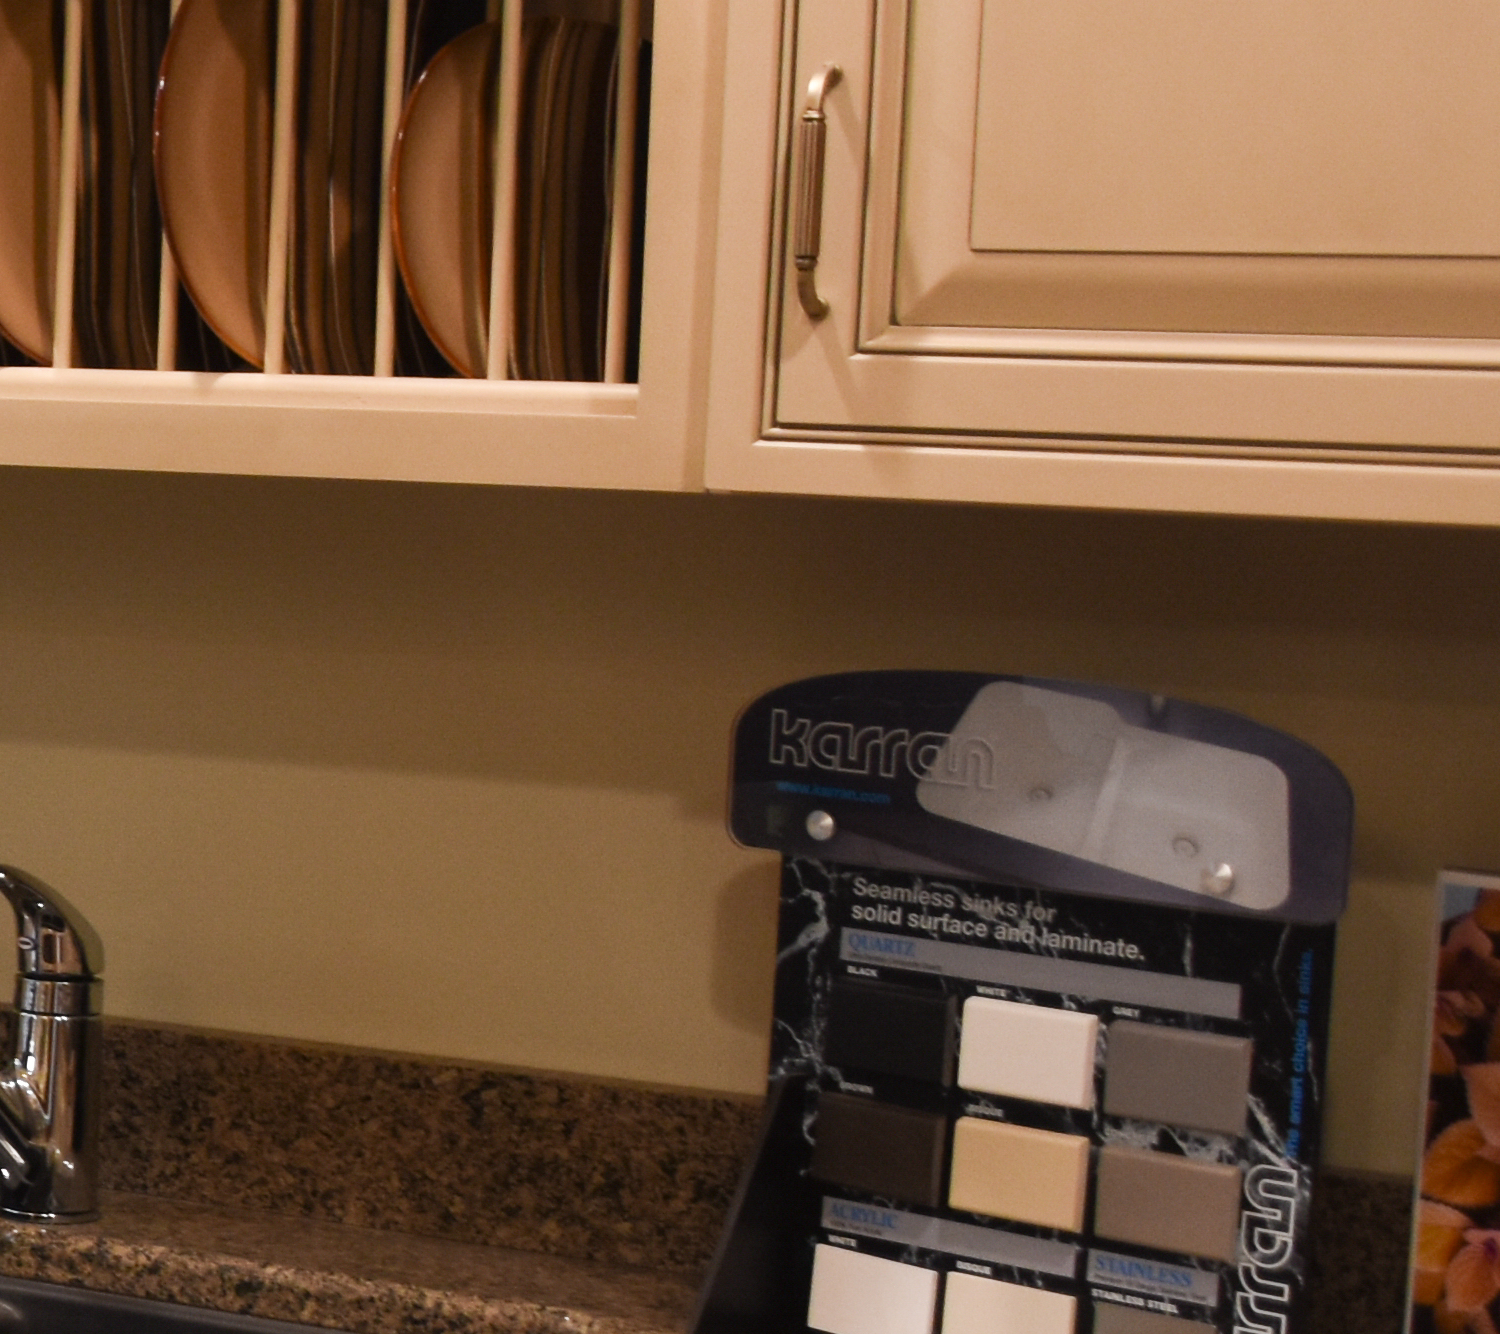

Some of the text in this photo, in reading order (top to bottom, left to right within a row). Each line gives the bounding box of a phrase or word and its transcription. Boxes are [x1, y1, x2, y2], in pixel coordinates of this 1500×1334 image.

[769, 708, 997, 791] karran
[853, 877, 1057, 922] Seamless sinks for
[851, 903, 1146, 962] solid surface and laminate.
[1298, 998, 1310, 1015] in
[1292, 1019, 1309, 1073] choice
[1289, 1076, 1304, 1125] smart
[1096, 1255, 1193, 1287] STAINLESS
